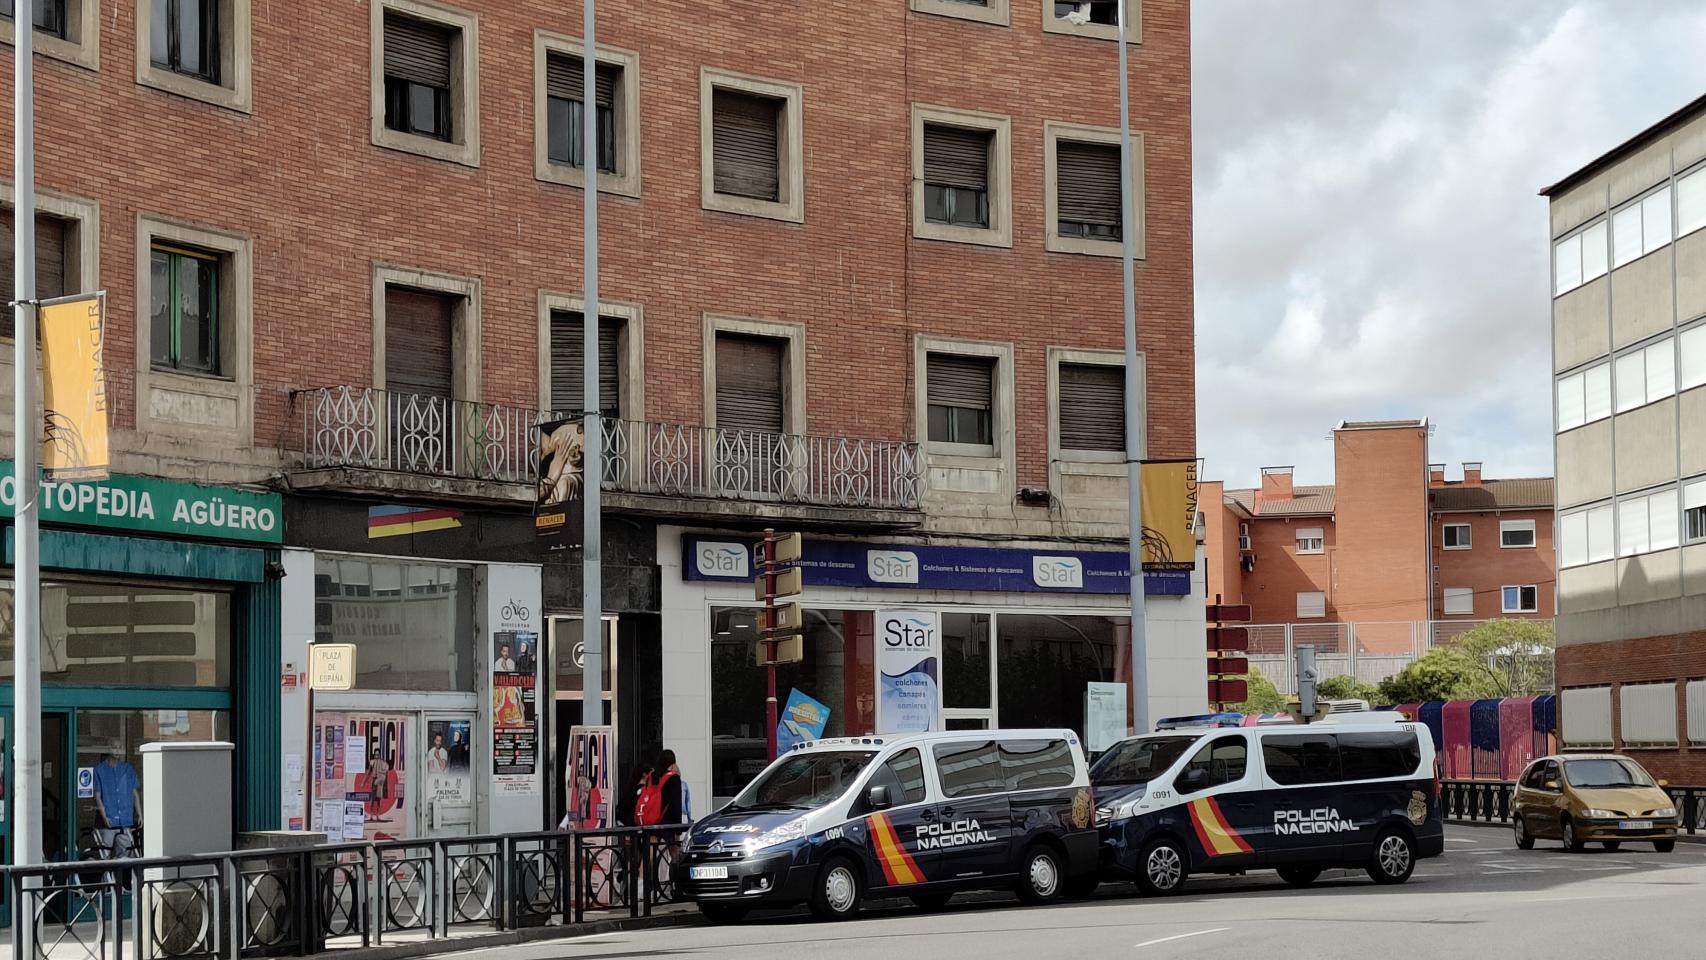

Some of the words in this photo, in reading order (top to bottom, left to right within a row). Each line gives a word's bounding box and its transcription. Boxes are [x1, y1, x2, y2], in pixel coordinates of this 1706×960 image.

[0, 476, 155, 520] OTOPEDIA
[172, 497, 275, 532] AGÜERO
[702, 548, 742, 572] Star
[819, 560, 827, 568] de
[828, 561, 855, 569] descanso
[873, 556, 913, 578] Star
[922, 564, 953, 573] Colchones
[954, 565, 960, 573] &
[961, 565, 986, 574] Sistemas
[987, 566, 995, 574] de
[996, 566, 1024, 575] descanso
[1038, 562, 1076, 583] Star
[1087, 569, 1117, 577] Colchones
[1159, 571, 1186, 579] descanso
[884, 619, 934, 647] Star
[322, 651, 342, 660] PLAZA
[327, 663, 336, 671] DE
[320, 673, 344, 683] ESPAÑA
[895, 679, 928, 688] colchones
[1274, 806, 1340, 823] POLICÍA
[916, 818, 980, 837] POLICÍA
[1275, 819, 1360, 835] NACIONAL
[917, 830, 997, 850] NACIONAL
